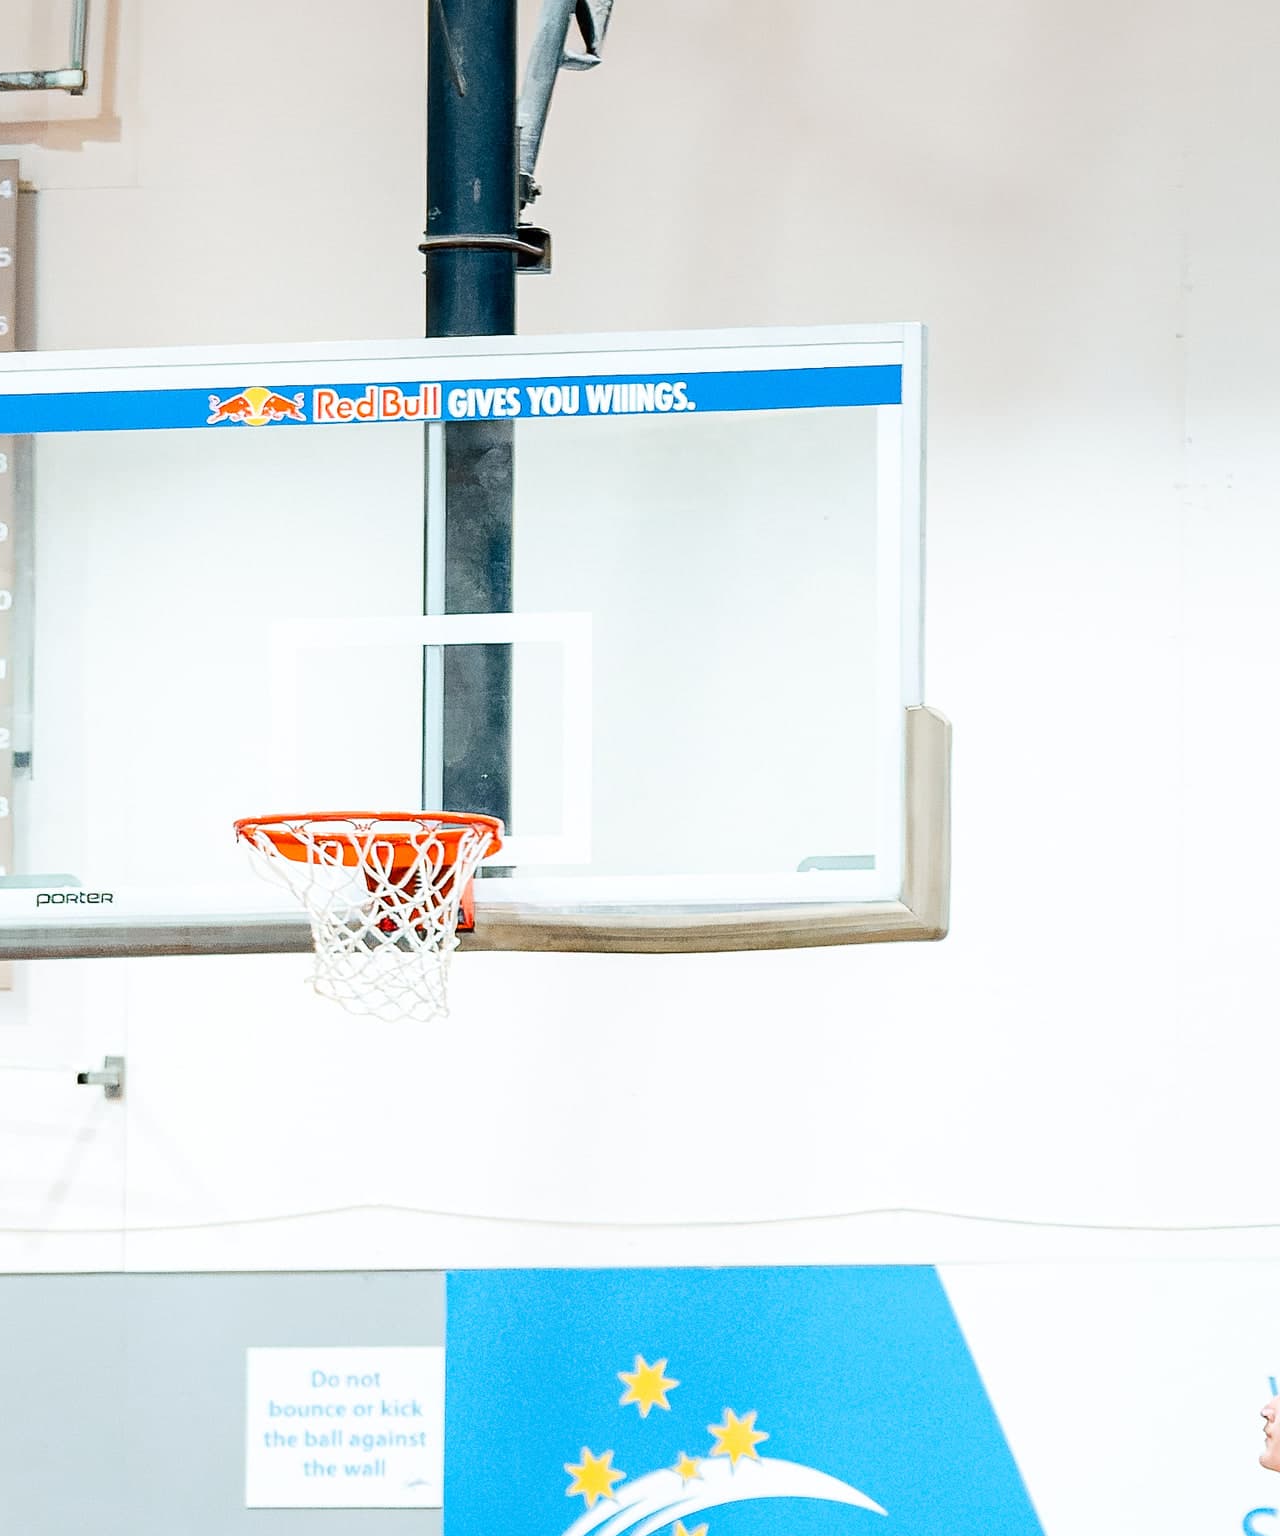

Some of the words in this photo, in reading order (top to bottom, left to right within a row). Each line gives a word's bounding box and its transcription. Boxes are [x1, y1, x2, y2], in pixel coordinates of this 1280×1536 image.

[317, 387, 374, 418] Red
[382, 386, 438, 417] Bull
[448, 388, 520, 418] GIVES
[527, 386, 579, 415] YOU
[311, 1370, 340, 1388] Do
[346, 1372, 381, 1388] not
[269, 1400, 346, 1418] bounce
[353, 1403, 373, 1418] or
[381, 1400, 423, 1418] kick
[264, 1430, 298, 1448] the
[305, 1430, 342, 1448] ball
[349, 1431, 427, 1452] against
[304, 1458, 337, 1477] the
[344, 1459, 386, 1477] wall
